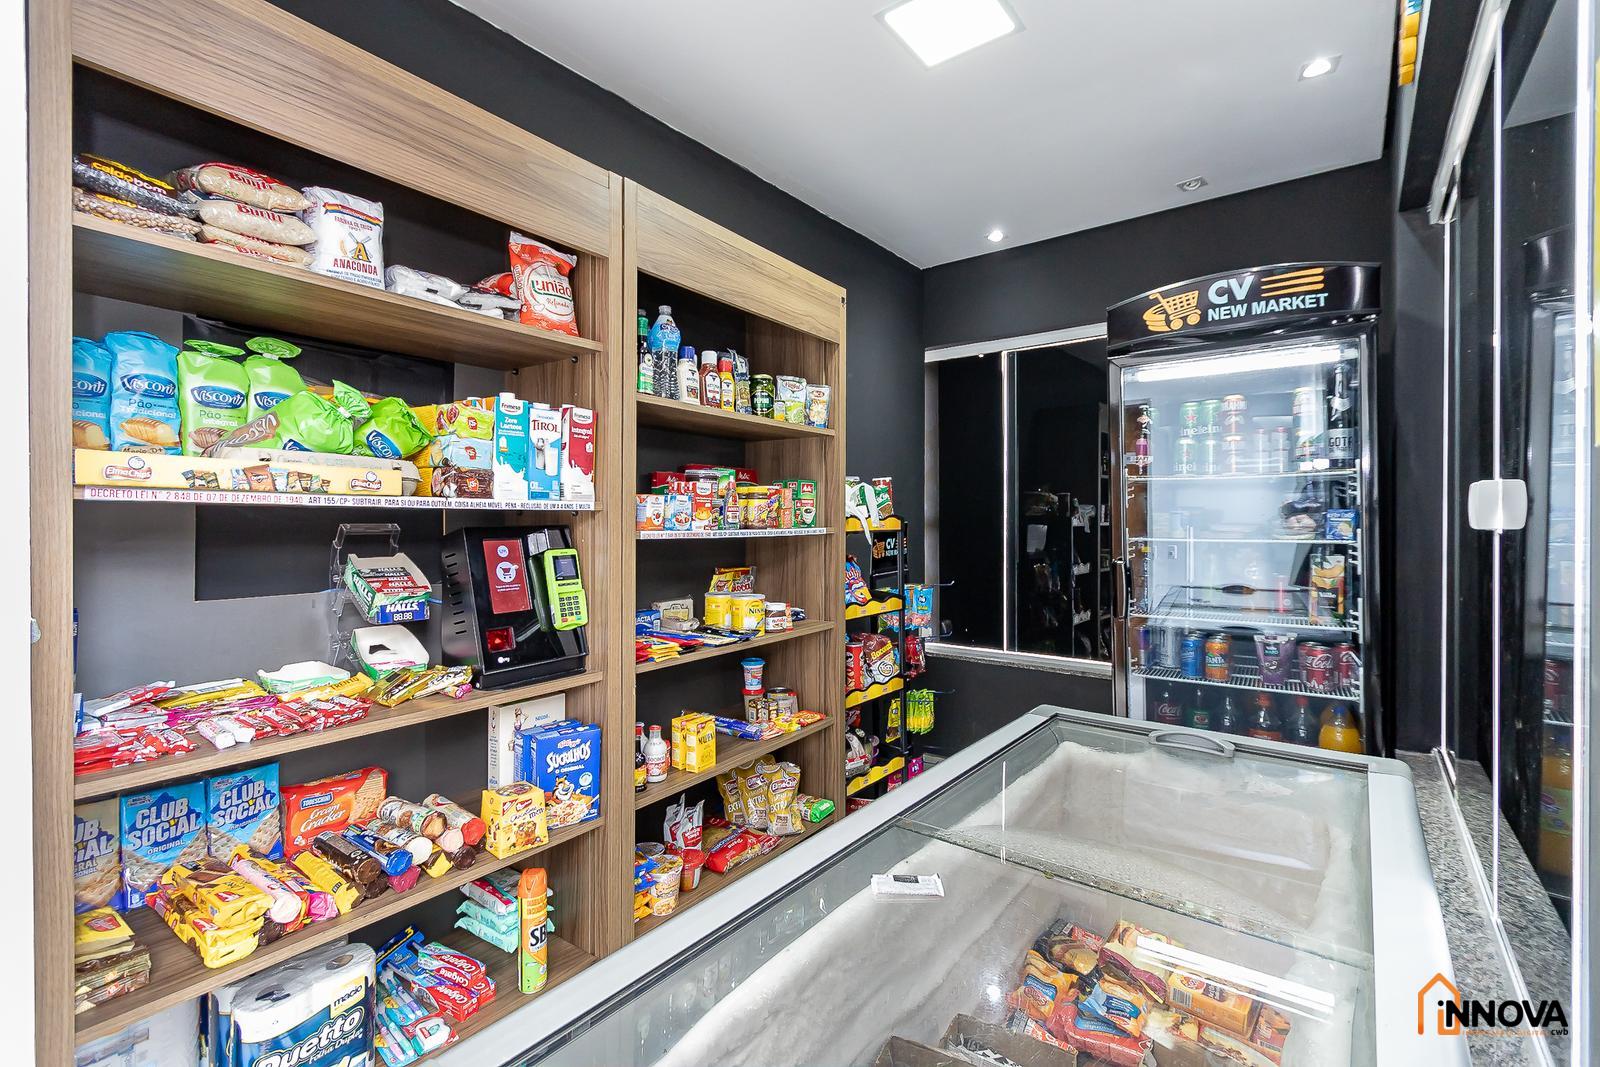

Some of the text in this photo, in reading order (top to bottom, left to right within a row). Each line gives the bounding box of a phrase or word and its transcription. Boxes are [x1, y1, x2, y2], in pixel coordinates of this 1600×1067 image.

[333, 258, 378, 276] ANACONDA
[1208, 275, 1254, 305] CV
[1208, 293, 1328, 321] NEW MARKET
[128, 398, 153, 409] Pão
[193, 388, 244, 405] Visconti
[199, 409, 222, 419] Pão
[90, 488, 133, 499] DECRETO
[231, 493, 272, 503] DEZEMBRO
[352, 497, 382, 506] SUBTRAIR
[384, 498, 400, 506] PARA
[353, 574, 373, 602] HALLS
[385, 602, 420, 613] HALLS
[220, 779, 265, 810] CLUB
[136, 797, 190, 829] CLUB
[300, 809, 346, 833] Cracker
[310, 804, 340, 820] Cream
[147, 840, 186, 855] ORIGINAL
[530, 924, 547, 947] SB
[439, 967, 469, 987] Colgate
[333, 984, 363, 1007] macio
